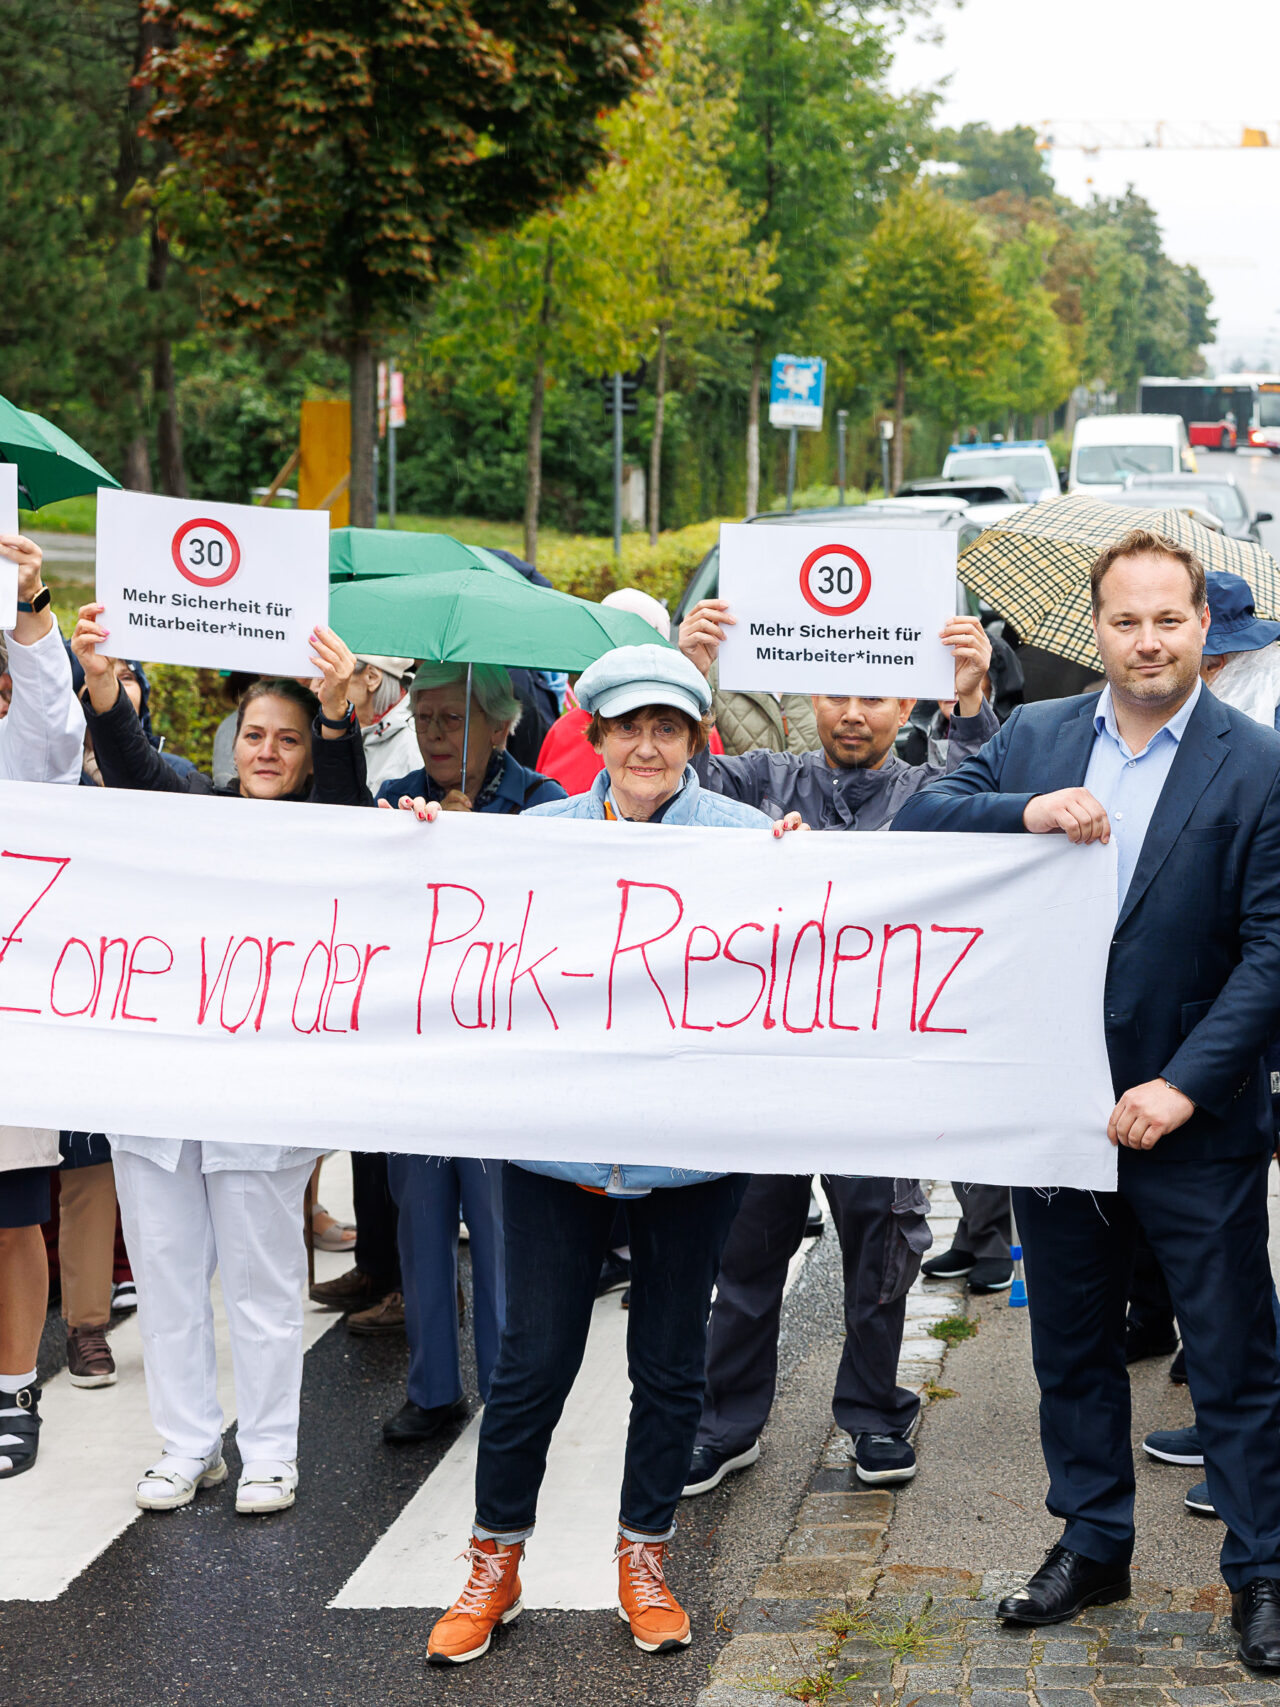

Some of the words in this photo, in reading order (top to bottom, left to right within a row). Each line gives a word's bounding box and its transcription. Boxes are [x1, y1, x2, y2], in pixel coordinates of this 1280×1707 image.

[189, 538, 223, 567] 30
[817, 565, 854, 596] 30
[123, 587, 167, 605] Mehr
[171, 592, 262, 616] Sicherheit
[265, 602, 293, 618] für
[750, 623, 796, 638] Mehr
[799, 624, 891, 641] Sicherheit
[893, 627, 922, 642] für
[197, 935, 296, 1034] vor
[291, 898, 391, 1035] der
